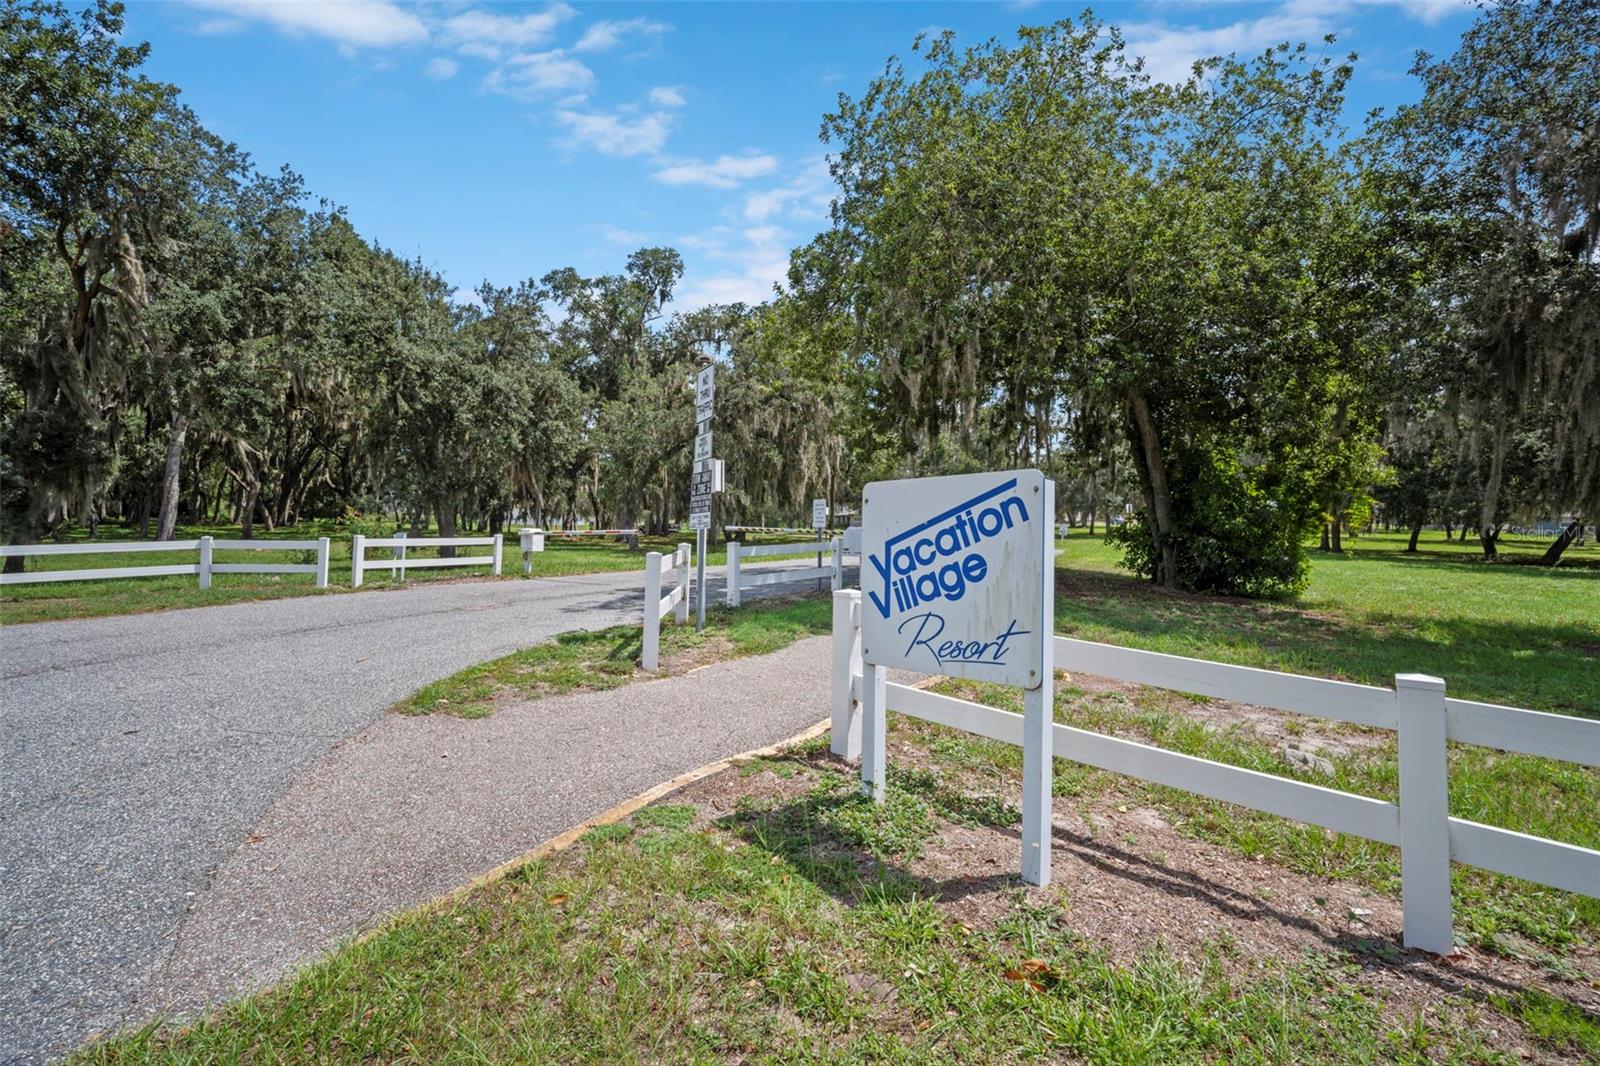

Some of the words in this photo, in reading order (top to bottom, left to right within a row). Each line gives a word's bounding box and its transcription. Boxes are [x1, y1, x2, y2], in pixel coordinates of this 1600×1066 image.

[697, 399, 713, 415] TRAFFIC
[703, 374, 709, 386] NO
[869, 493, 1030, 580] Vacation
[868, 553, 988, 619] Village
[898, 611, 1031, 667] Resort
